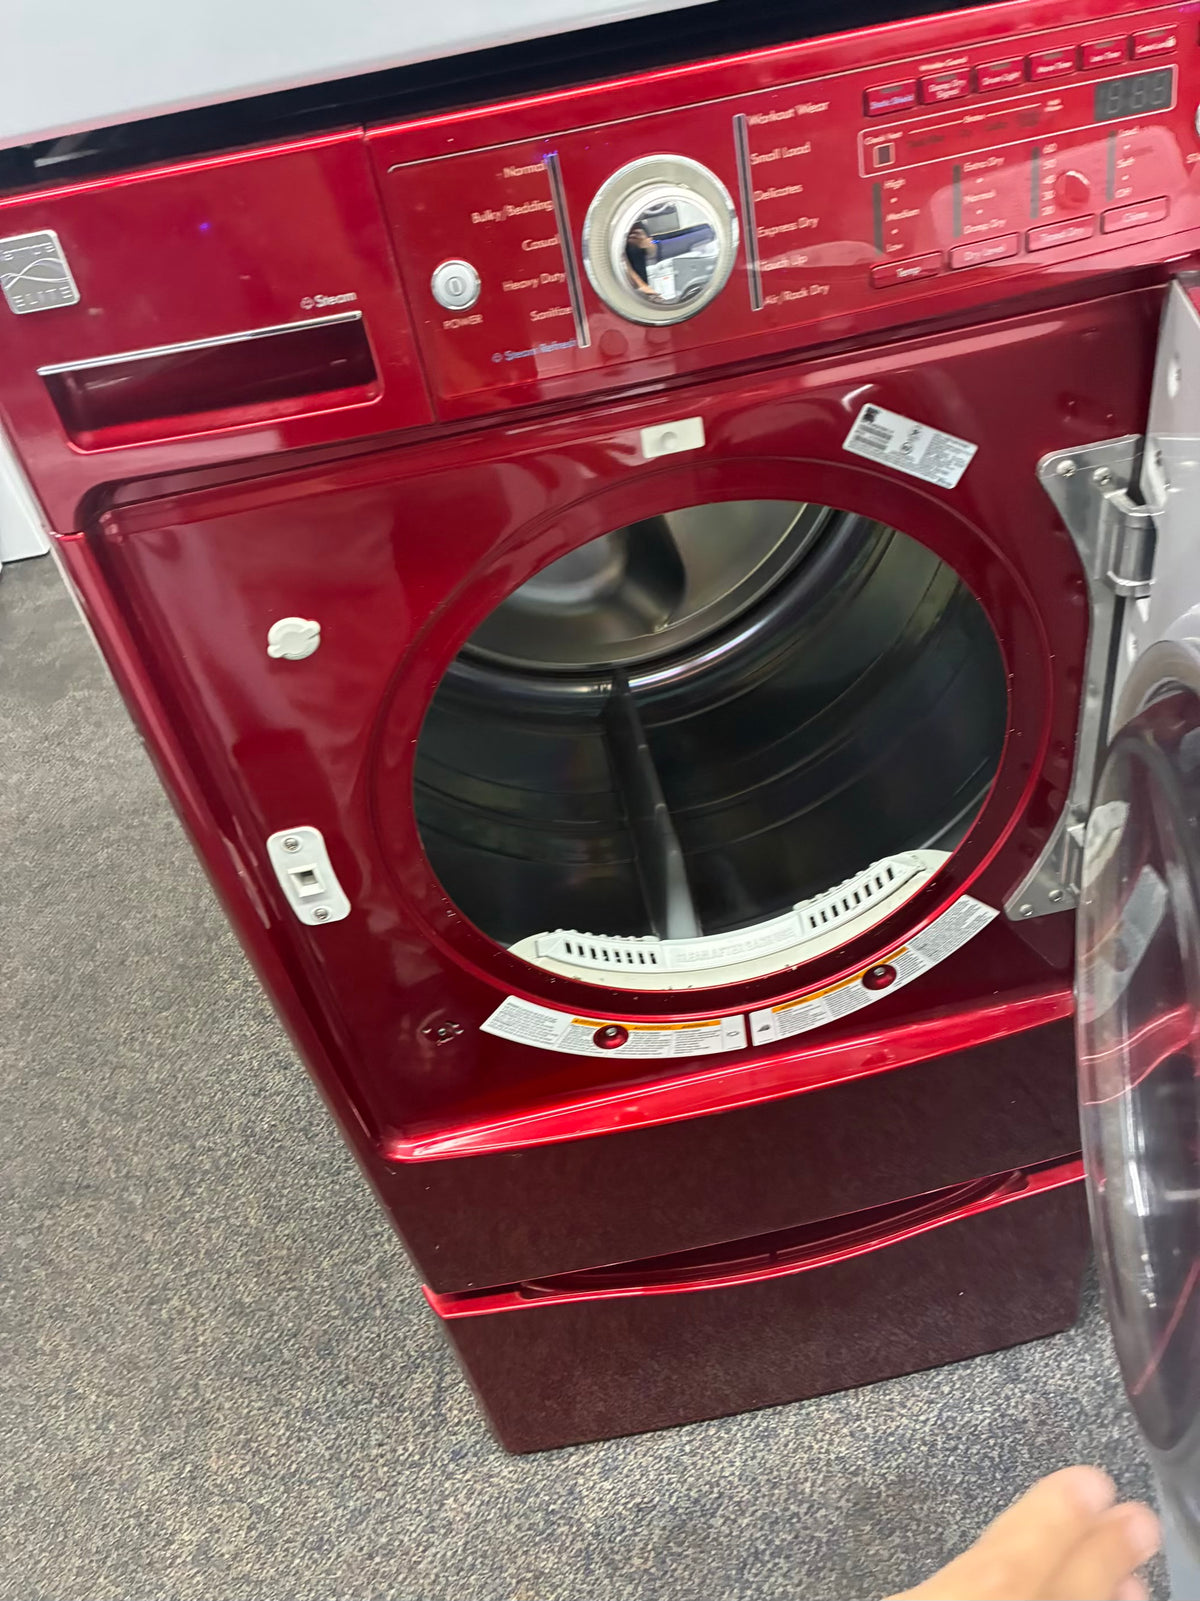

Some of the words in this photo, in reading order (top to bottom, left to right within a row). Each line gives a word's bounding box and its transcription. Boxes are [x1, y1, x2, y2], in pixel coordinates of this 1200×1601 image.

[796, 101, 830, 115] Wear
[750, 149, 780, 165] Small
[754, 184, 803, 201] Delicates
[471, 199, 553, 224] Bulky/Bedding
[758, 222, 797, 238] Express
[798, 216, 819, 229] Dry
[522, 235, 560, 252] Casual
[503, 277, 538, 292] Heavy
[810, 284, 830, 296] Dry
[314, 292, 357, 308] Steam
[443, 314, 483, 330] POWER
